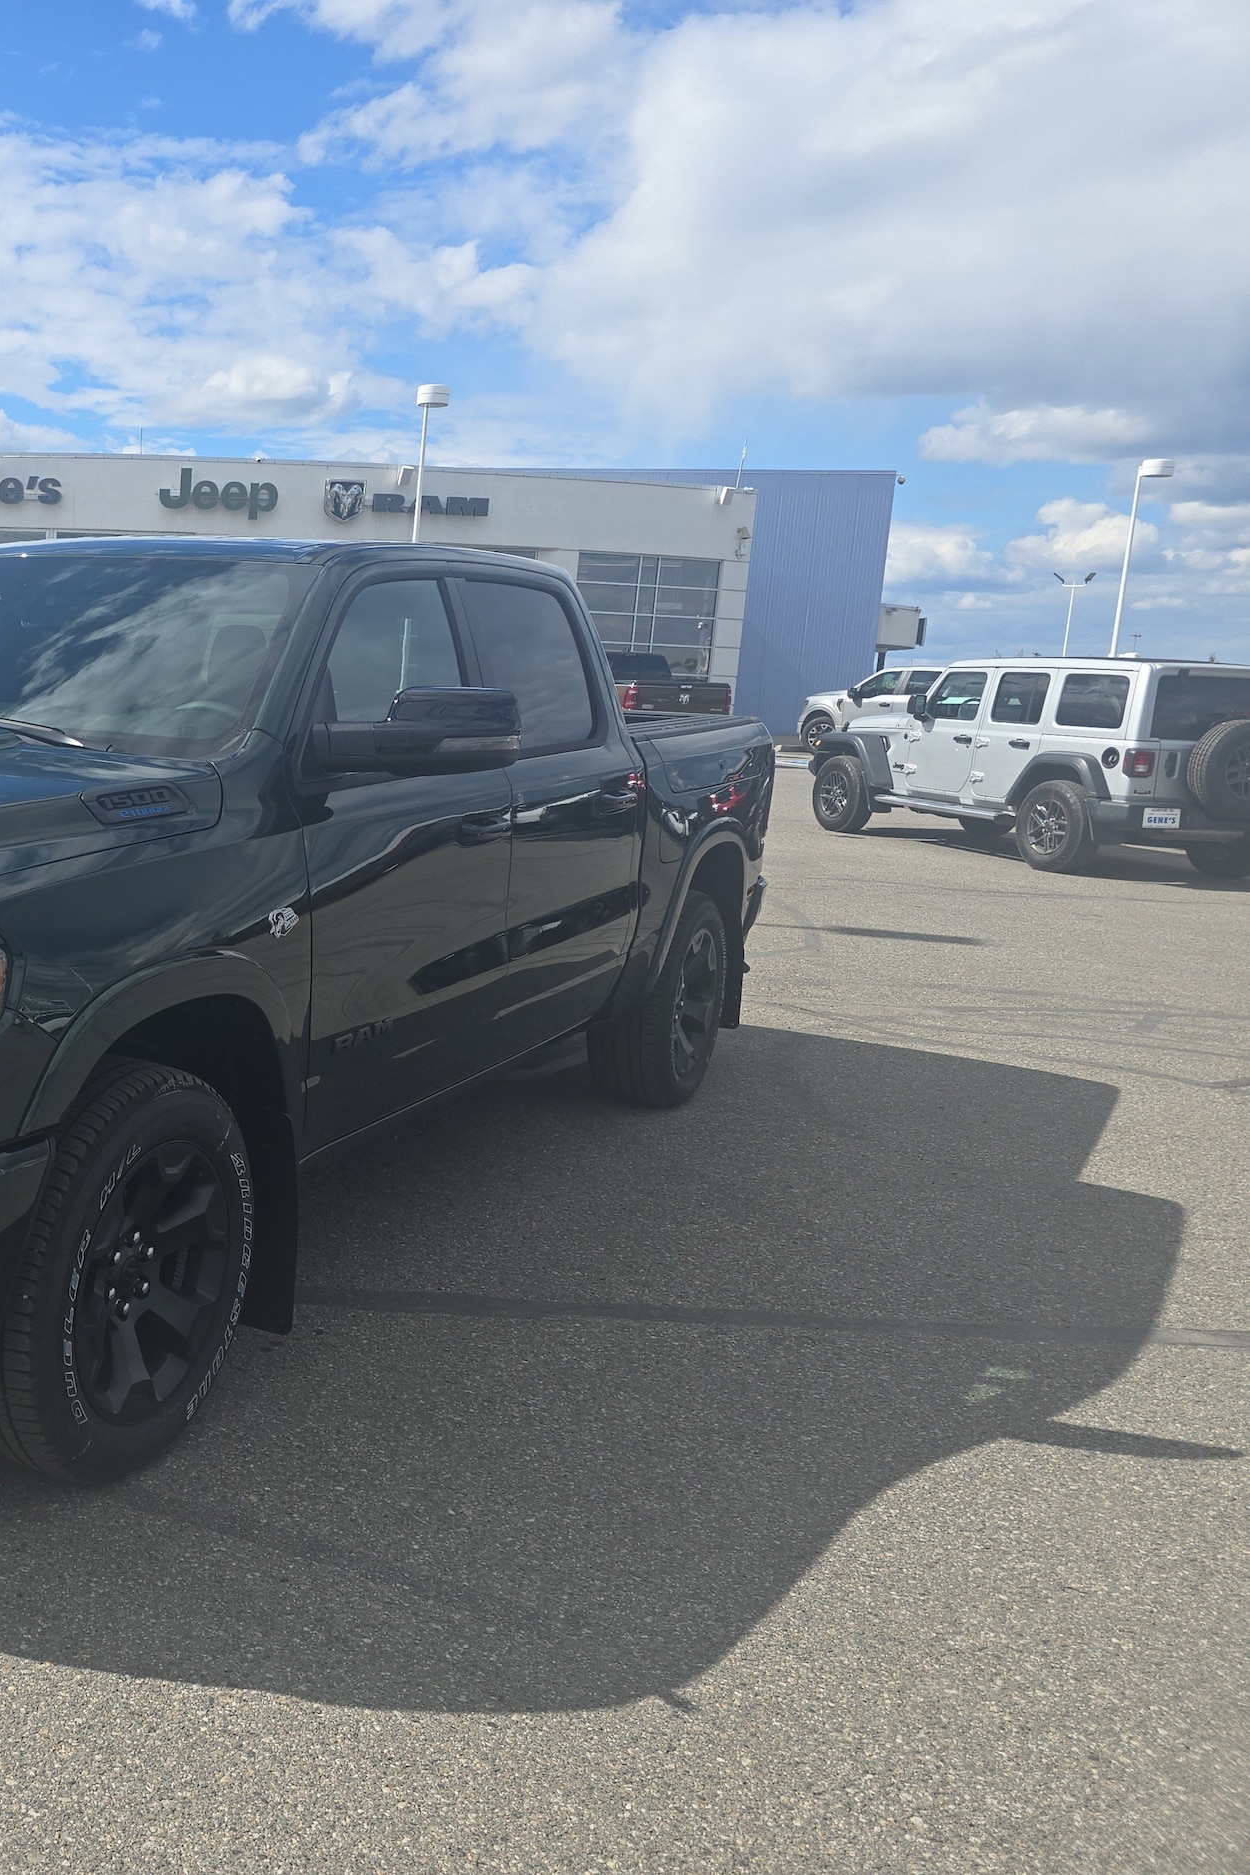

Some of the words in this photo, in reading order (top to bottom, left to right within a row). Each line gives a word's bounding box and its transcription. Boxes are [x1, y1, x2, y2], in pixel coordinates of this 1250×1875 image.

[159, 468, 278, 520] Jeep
[371, 493, 489, 516] RAM
[99, 788, 171, 810] 1500
[1147, 816, 1176, 824] GENE'S
[330, 1017, 394, 1053] RAM
[186, 1152, 253, 1421] BRIDGESTONE
[62, 1229, 92, 1426] DUELER
